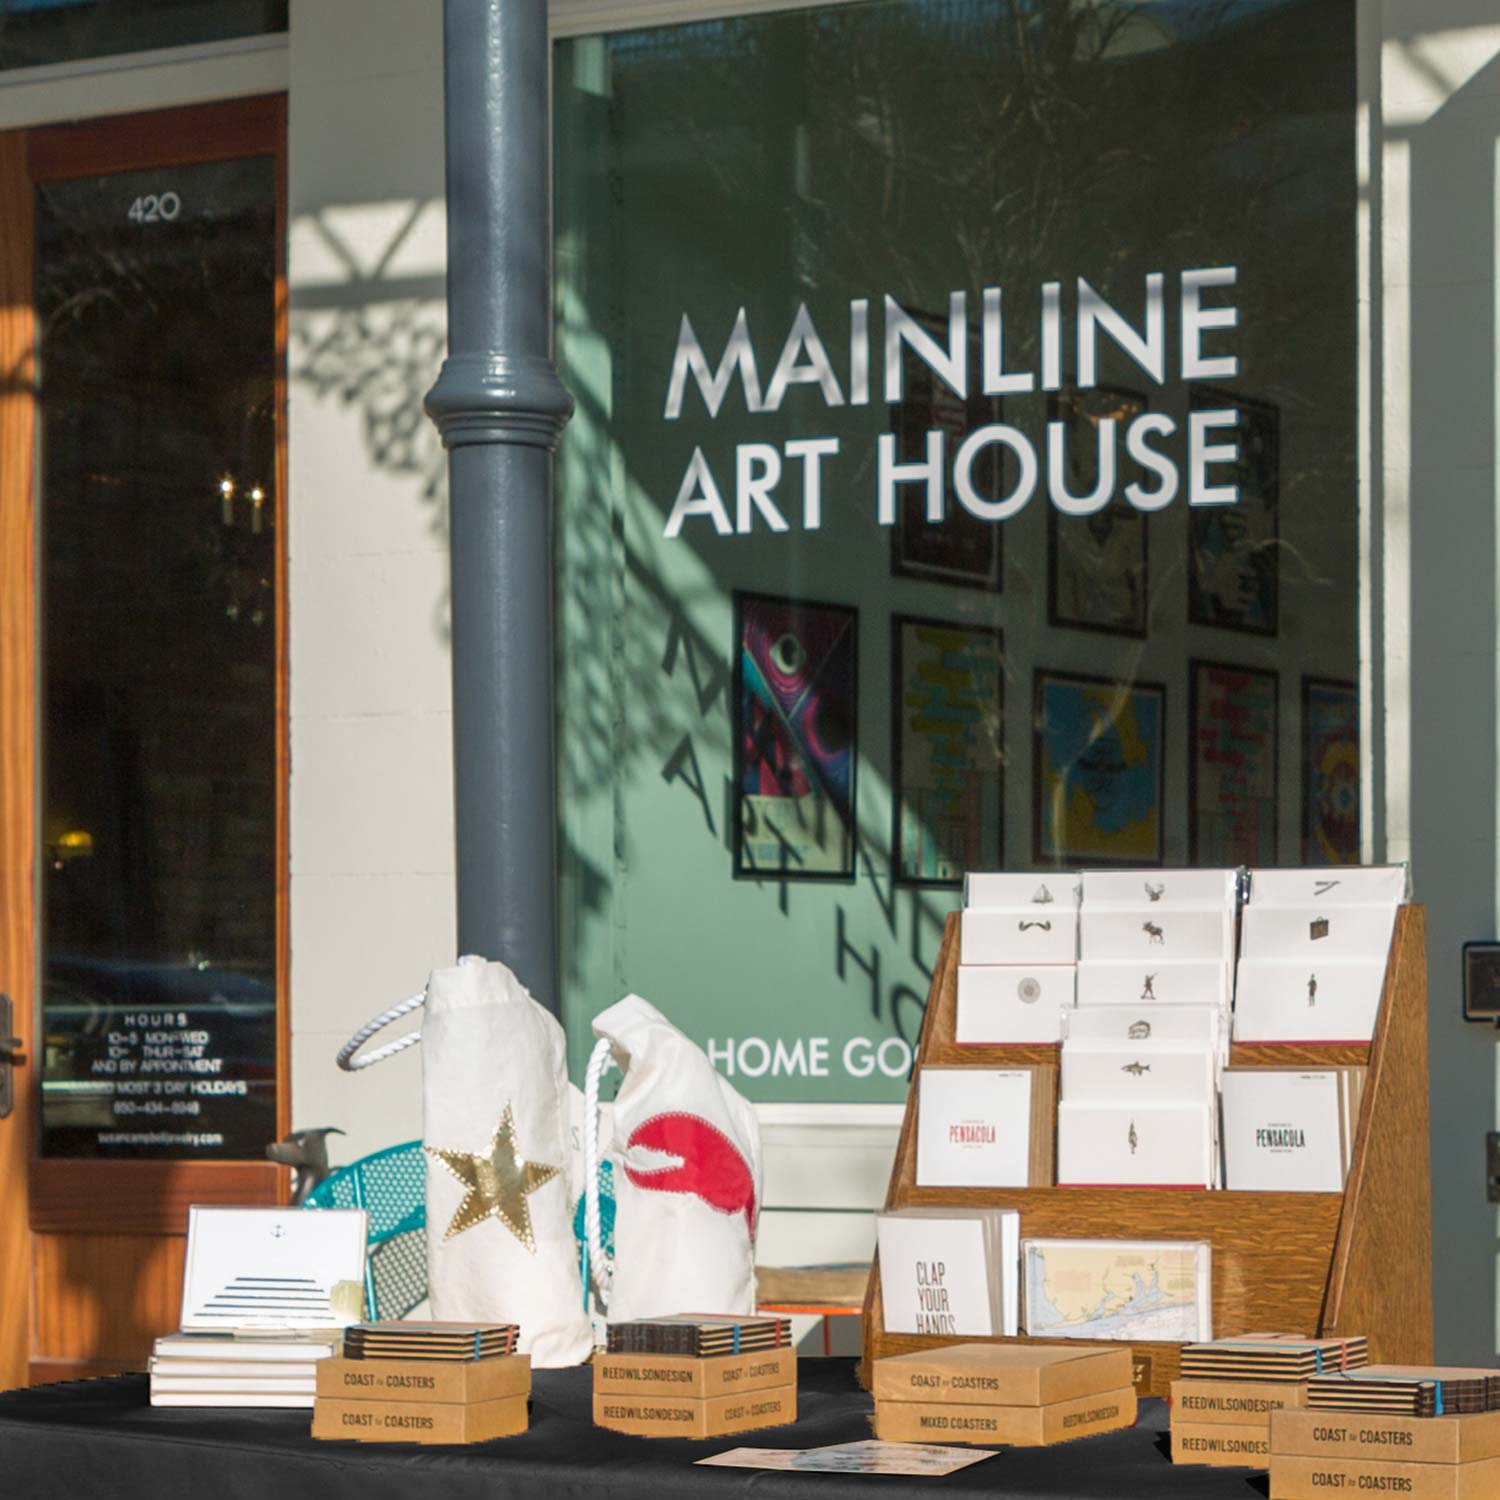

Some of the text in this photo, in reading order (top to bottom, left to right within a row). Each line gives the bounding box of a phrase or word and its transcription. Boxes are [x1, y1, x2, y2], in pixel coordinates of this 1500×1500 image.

[127, 192, 181, 222] 420
[664, 267, 1237, 418] MAINLINE
[663, 409, 1239, 538] ART HOUSE
[125, 1013, 187, 1026] HOURS
[707, 1037, 919, 1077] HOME GO
[91, 1059, 223, 1072] AND BY APPOINTMENT
[118, 1081, 149, 1094] MOST
[164, 1081, 187, 1094] DAY
[191, 1081, 247, 1094] HOLIDAYS
[949, 1125, 996, 1143] PENSACOLA
[1256, 1129, 1305, 1147] PENSACOLA
[916, 1261, 945, 1286] CLAP
[917, 1288, 949, 1312] YOUR
[916, 1314, 956, 1335] HANDS
[344, 1373, 375, 1386] COAST
[386, 1375, 435, 1389] COASTERS
[602, 1367, 693, 1382] REEDWILSONDESIGN
[723, 1368, 742, 1382] COAST
[911, 1375, 941, 1387] COAST
[951, 1377, 999, 1390] COASTERS
[1181, 1396, 1284, 1412] REEDWILSONDESIGN
[342, 1413, 373, 1426] COAST
[385, 1415, 433, 1429] COASTERS
[604, 1406, 694, 1422] REEDWILSONDESIGN
[725, 1407, 744, 1421] COAST
[920, 1416, 998, 1431] MIXED COASTERS
[1313, 1427, 1347, 1442] COAST
[1359, 1429, 1413, 1445] COASTERS
[1182, 1438, 1268, 1454] REEDWILSONDES
[1312, 1472, 1346, 1487] COAST
[1358, 1475, 1412, 1491] COASTERS
